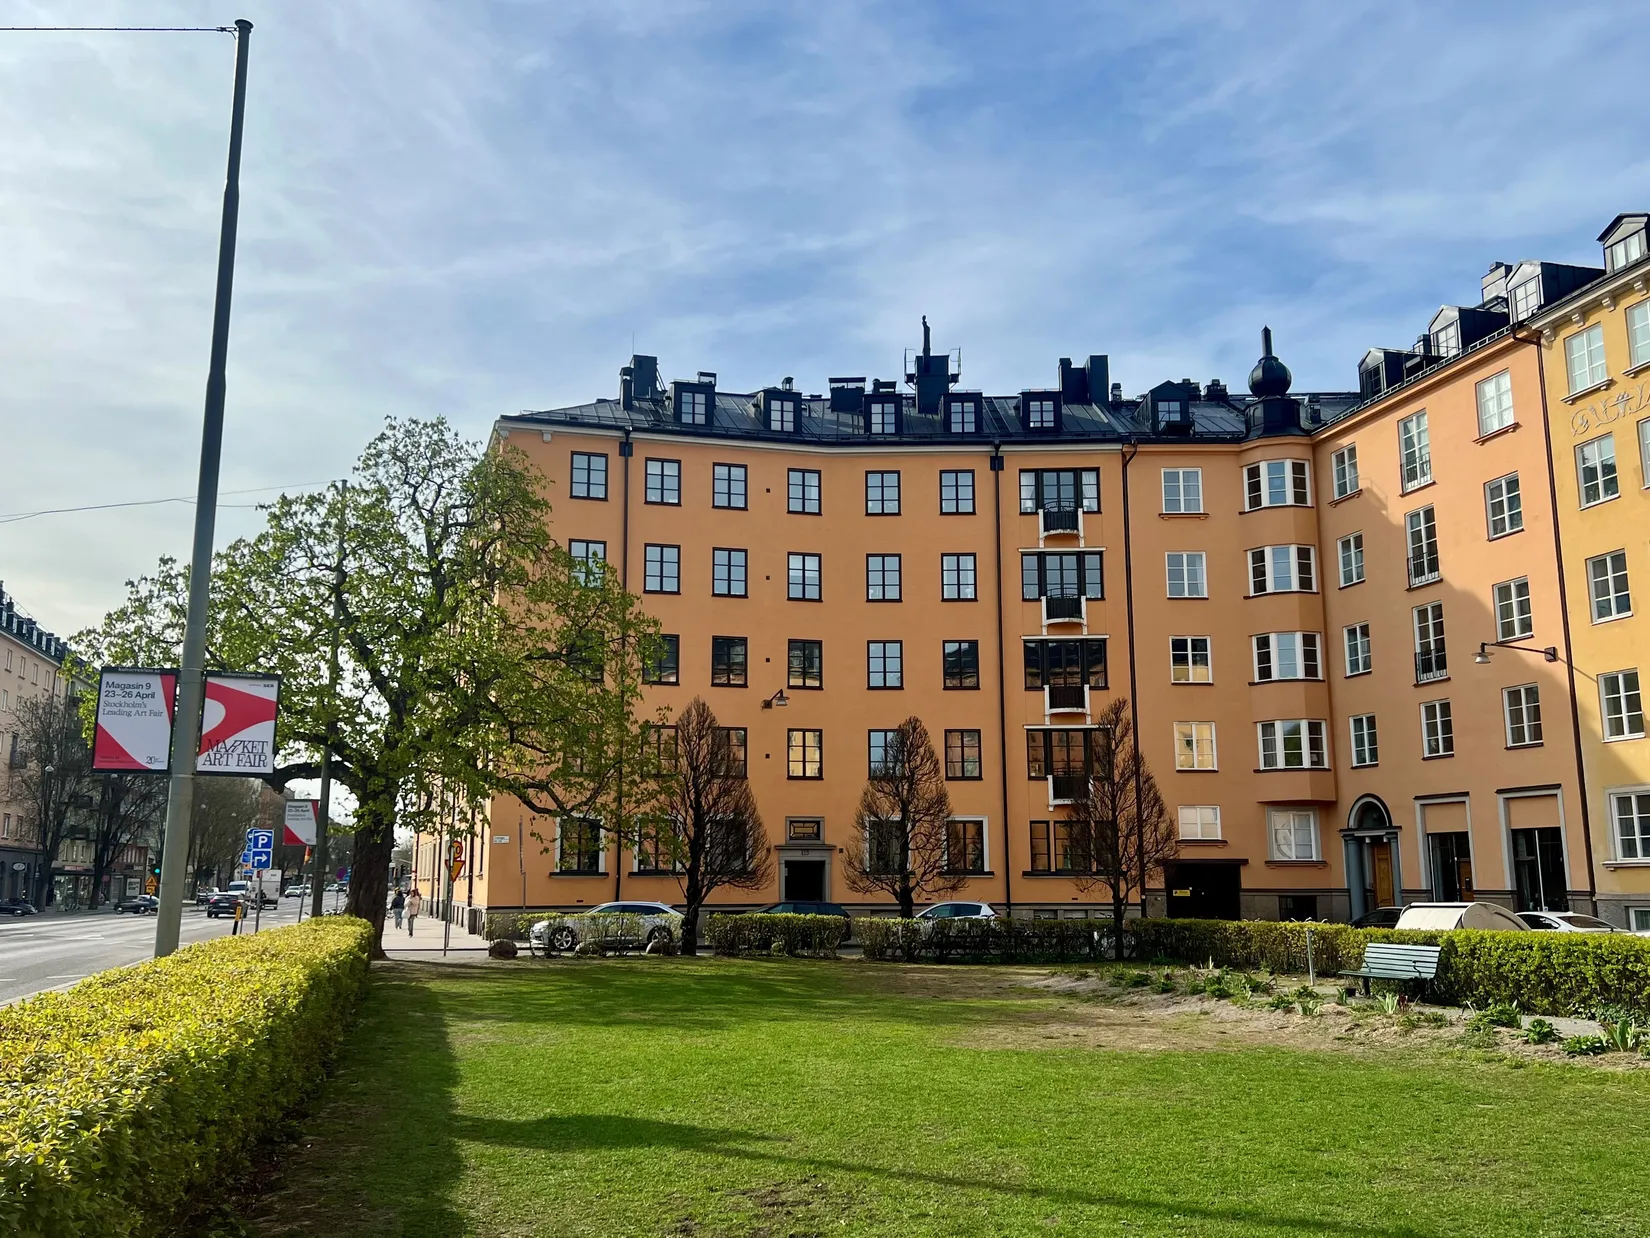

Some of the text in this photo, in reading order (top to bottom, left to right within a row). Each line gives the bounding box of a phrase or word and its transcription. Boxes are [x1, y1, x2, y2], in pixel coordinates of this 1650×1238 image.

[105, 681, 152, 691] Magasin 9
[134, 691, 156, 700] April
[103, 700, 147, 709] Stockholm's
[102, 708, 164, 717] Leading Art Fair
[206, 739, 269, 754] MARKET
[201, 752, 268, 768] ART FAIR
[258, 836, 268, 848] P
